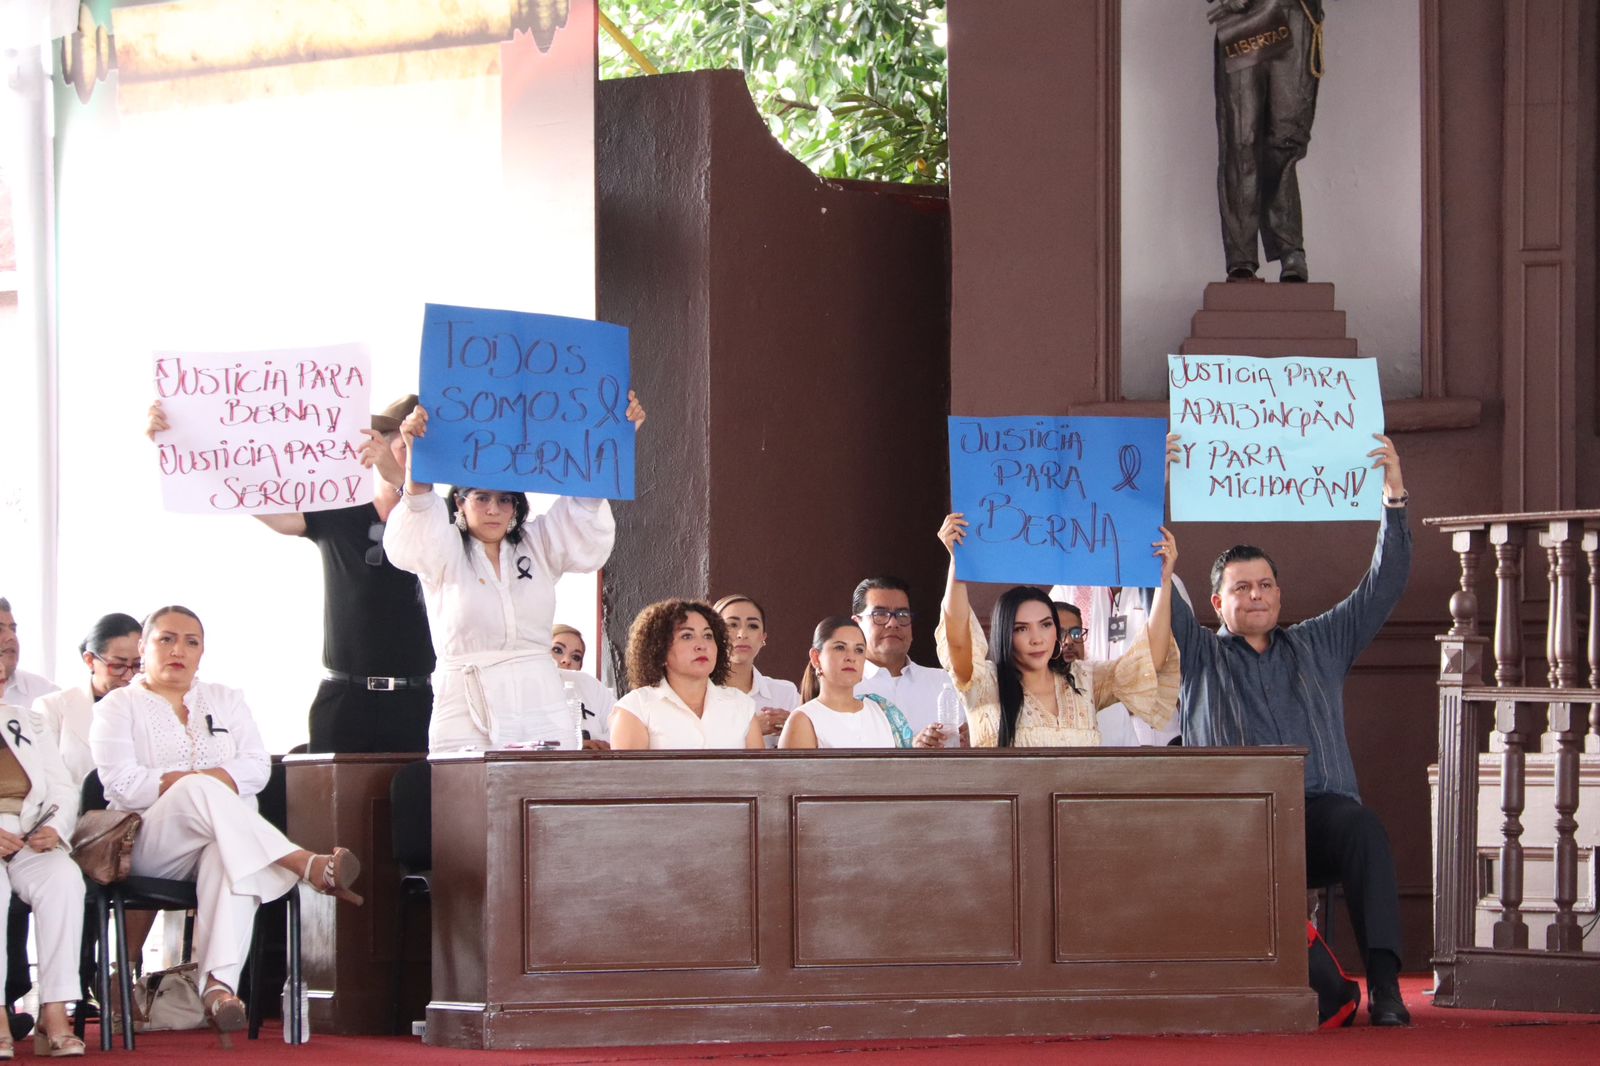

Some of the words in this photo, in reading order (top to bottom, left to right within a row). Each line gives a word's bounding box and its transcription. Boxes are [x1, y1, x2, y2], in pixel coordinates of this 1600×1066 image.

[1225, 26, 1290, 58] LIBERTAD
[434, 320, 587, 379] TODOS
[296, 360, 364, 398] PARA
[1284, 362, 1356, 400] PARA
[435, 386, 588, 451] SOMOS
[284, 439, 358, 465] PARA
[463, 429, 622, 497] BERNA
[1182, 442, 1196, 469] Y
[1209, 440, 1286, 471] PARA
[991, 458, 1086, 500] PARA
[976, 492, 1131, 585] BERNA
